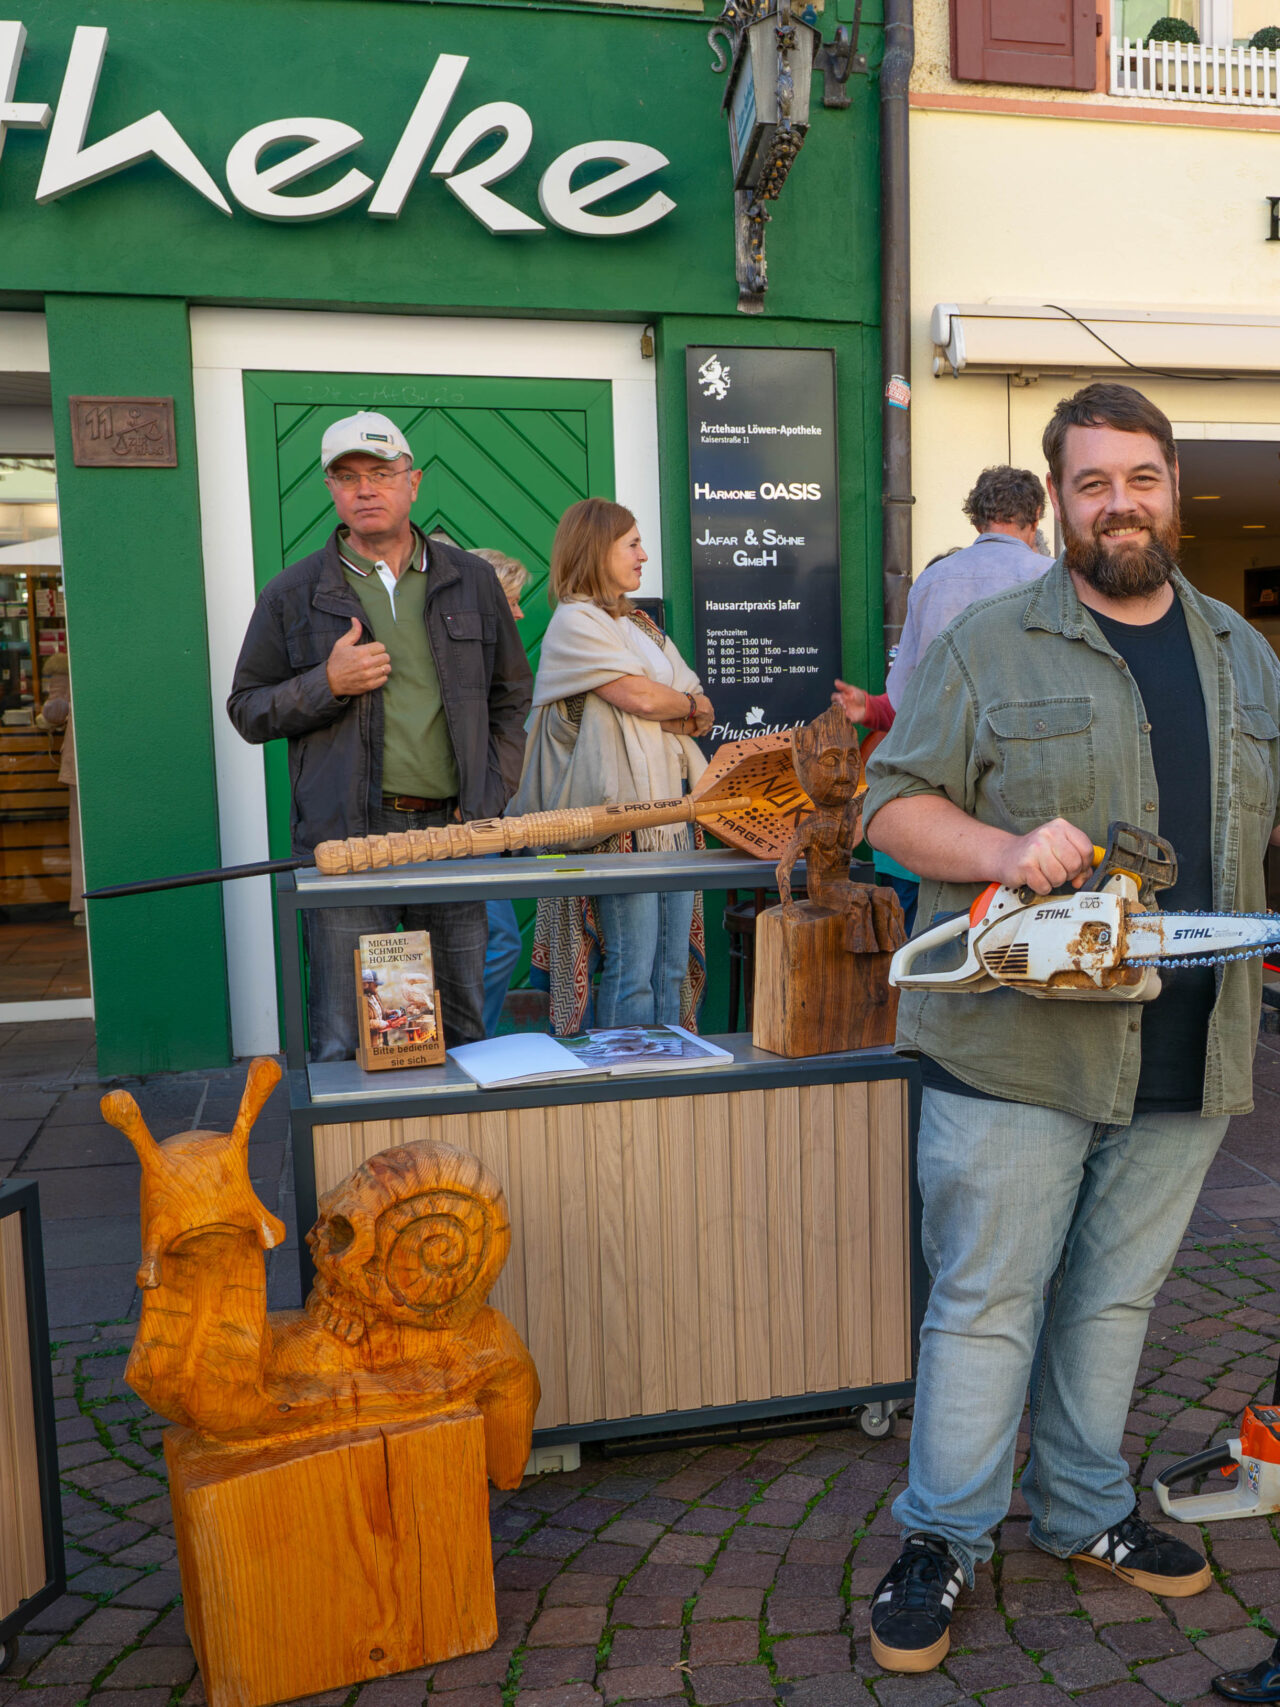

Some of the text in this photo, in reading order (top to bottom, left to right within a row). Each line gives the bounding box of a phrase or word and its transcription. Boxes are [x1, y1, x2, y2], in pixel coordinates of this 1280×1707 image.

[84, 406, 114, 441] 11
[701, 422, 822, 437] Ärztehaus Löwen-Apotheke
[701, 436, 750, 444] Kaiserstraße 11
[759, 482, 822, 501] OASIS
[744, 528, 759, 546] &
[705, 599, 801, 612] Hausarztpraxis Jafar
[706, 629, 748, 637] Sprechzeiten
[742, 638, 759, 646] 13:00
[760, 638, 773, 646] Uhr
[707, 648, 715, 656] Di
[764, 647, 782, 655] 15:00
[788, 647, 805, 655] 18:00
[806, 647, 819, 655] Uhr
[721, 657, 735, 665] 8:00
[742, 657, 759, 665] 13:00
[760, 657, 773, 665] Uhr
[708, 667, 718, 675] Do
[721, 676, 736, 684] 8:00
[743, 676, 760, 684] 13:00
[761, 676, 774, 684] Uhr
[710, 720, 805, 742] PhysioW
[624, 800, 682, 812] PRO GRIP
[716, 813, 778, 852] TARGET
[1034, 908, 1072, 920] STIHL
[1173, 928, 1213, 939] STIHL
[368, 938, 409, 948] MICHAEL
[368, 947, 404, 956] SCHMID
[369, 953, 423, 964] HOLZKUNST
[373, 1042, 440, 1056] Bitte bedienen
[391, 1056, 427, 1067] sie sich
